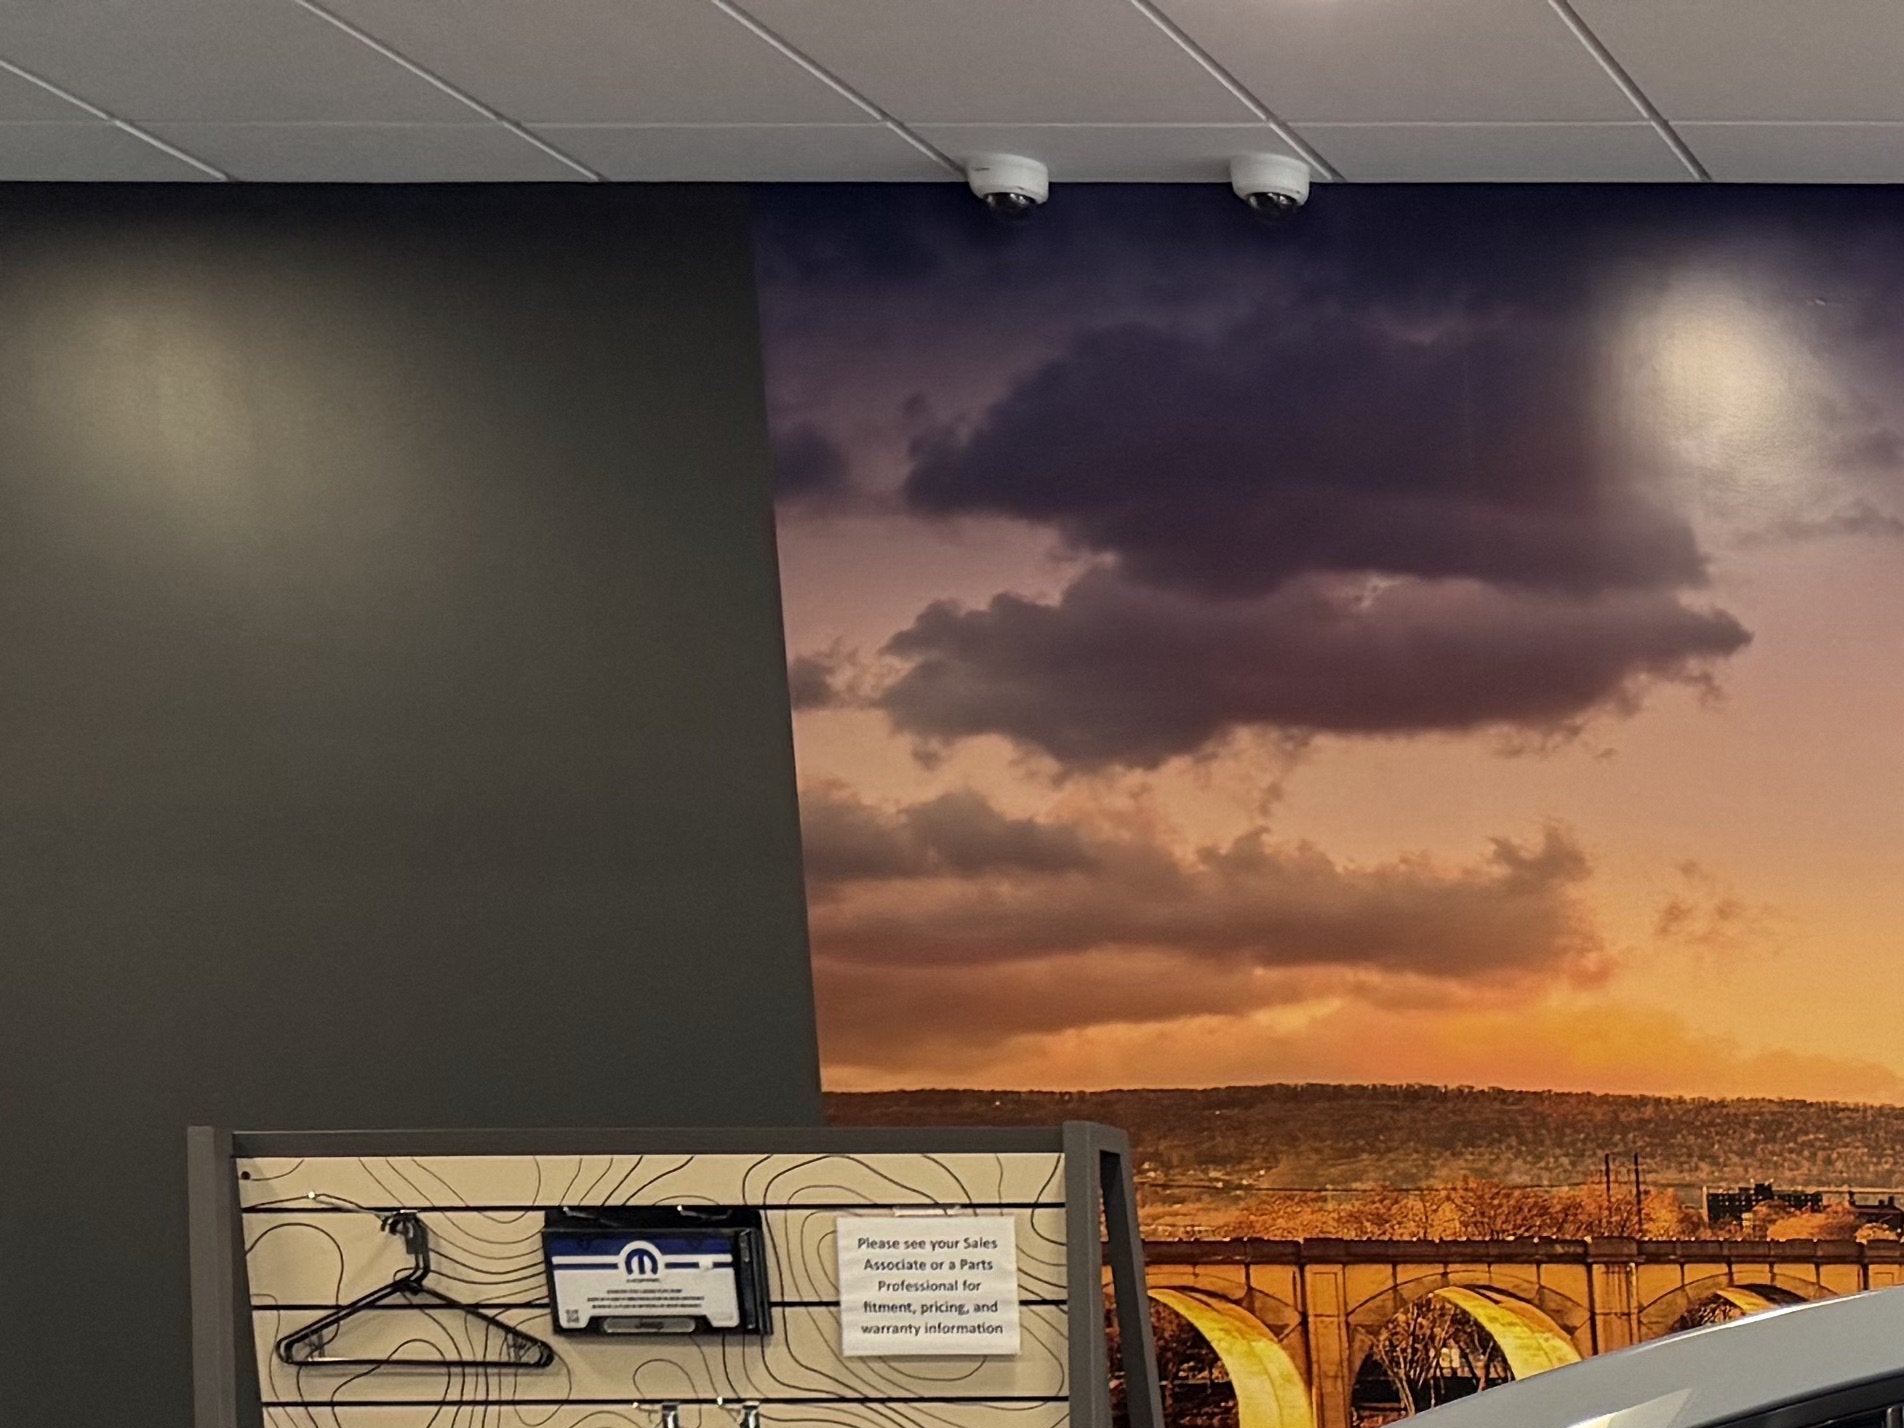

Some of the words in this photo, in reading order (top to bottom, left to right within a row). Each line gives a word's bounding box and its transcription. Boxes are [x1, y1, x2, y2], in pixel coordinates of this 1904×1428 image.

[857, 1237, 900, 1249] Please
[903, 1240, 926, 1249] see
[930, 1240, 960, 1251] your
[963, 1237, 998, 1249] Sales
[864, 1258, 926, 1270] Associate
[930, 1261, 944, 1270] or
[948, 1261, 956, 1270] a
[960, 1259, 993, 1270] Parts
[878, 1280, 958, 1291] Professional
[962, 1280, 981, 1291] for
[864, 1301, 916, 1314] fitment,
[920, 1301, 969, 1315] pricing,
[973, 1301, 998, 1313] and
[861, 1323, 921, 1336] warranty
[924, 1322, 1003, 1334] information
